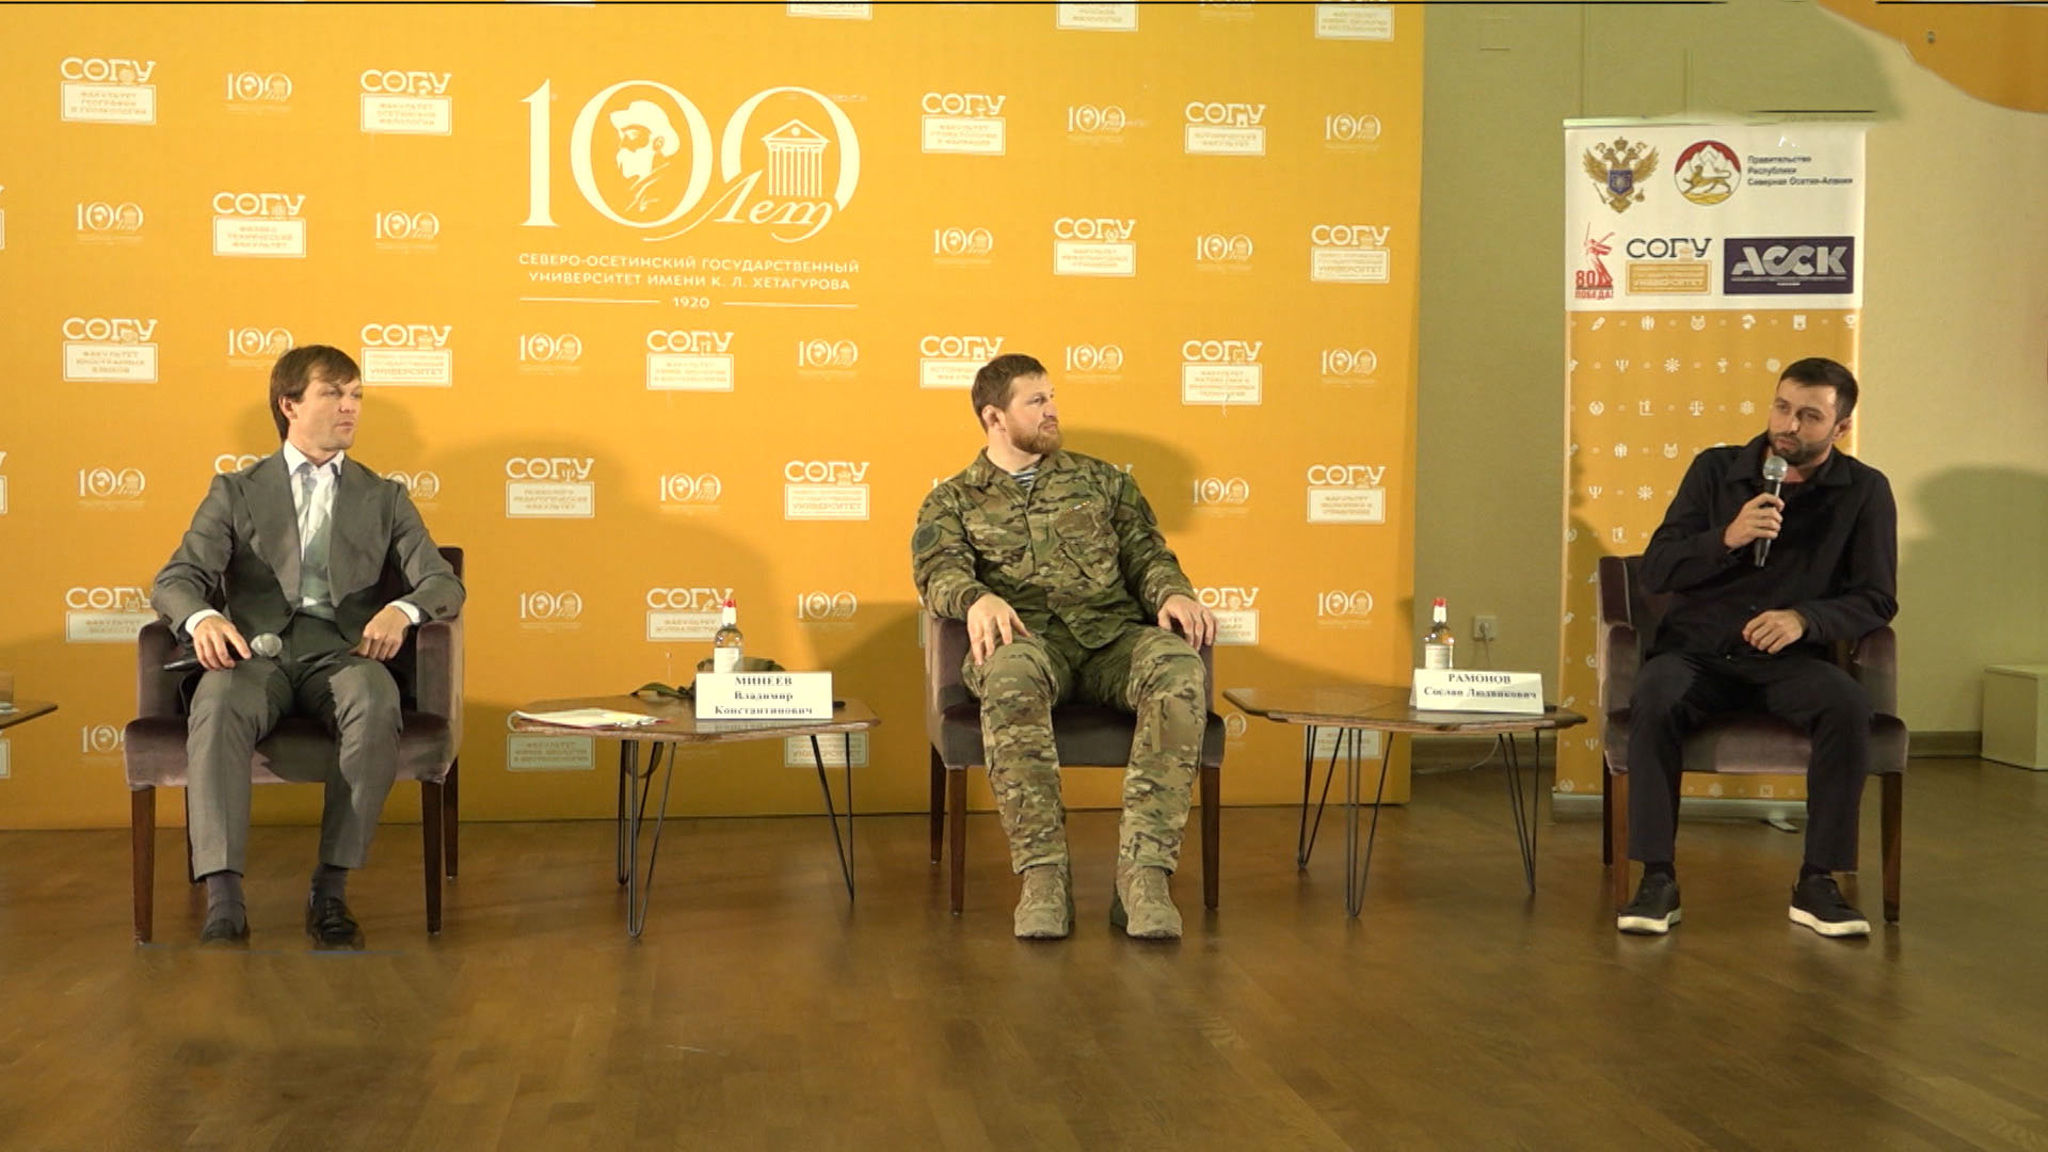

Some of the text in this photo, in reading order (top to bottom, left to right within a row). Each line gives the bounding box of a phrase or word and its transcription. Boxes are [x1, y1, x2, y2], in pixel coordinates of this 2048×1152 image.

[61, 57, 156, 82] СОГУ
[360, 69, 452, 93] СОГУ
[922, 92, 1006, 115] СОГУ
[1186, 102, 1266, 124] СОГУ
[520, 79, 860, 228] 100
[213, 192, 306, 215] СОГУ
[1054, 217, 1135, 239] СОГУ
[1311, 225, 1390, 246] СОГУ
[1626, 238, 1713, 258] СОГУ
[518, 252, 860, 274] СЕВЕРО-ОСЕТИНСКИЙ ГОСУДАРСТВЕННЫЙ
[1731, 244, 1848, 275] АССК
[528, 271, 851, 291] УНИВЕРСИТЕТ ИМЕНИ К. Л. ХЕТАГУРОВА
[672, 296, 711, 309] 1920
[63, 318, 158, 341] СОГУ
[361, 324, 452, 346] СОГУ
[647, 330, 734, 352] СОГУ
[920, 336, 1003, 358] СОГУ
[1183, 341, 1262, 361] СОГУ
[506, 458, 594, 479] СОГУ
[785, 461, 869, 482] СОГУ
[1308, 465, 1386, 485] СОГУ
[1194, 587, 1259, 608] ОГУ
[735, 676, 793, 686] МИНЕЕВ
[1448, 673, 1512, 684] РАМОНОВ
[734, 690, 794, 702] Владимир
[1423, 686, 1537, 699] Сослан Людвикович
[714, 705, 813, 715] Константинович
